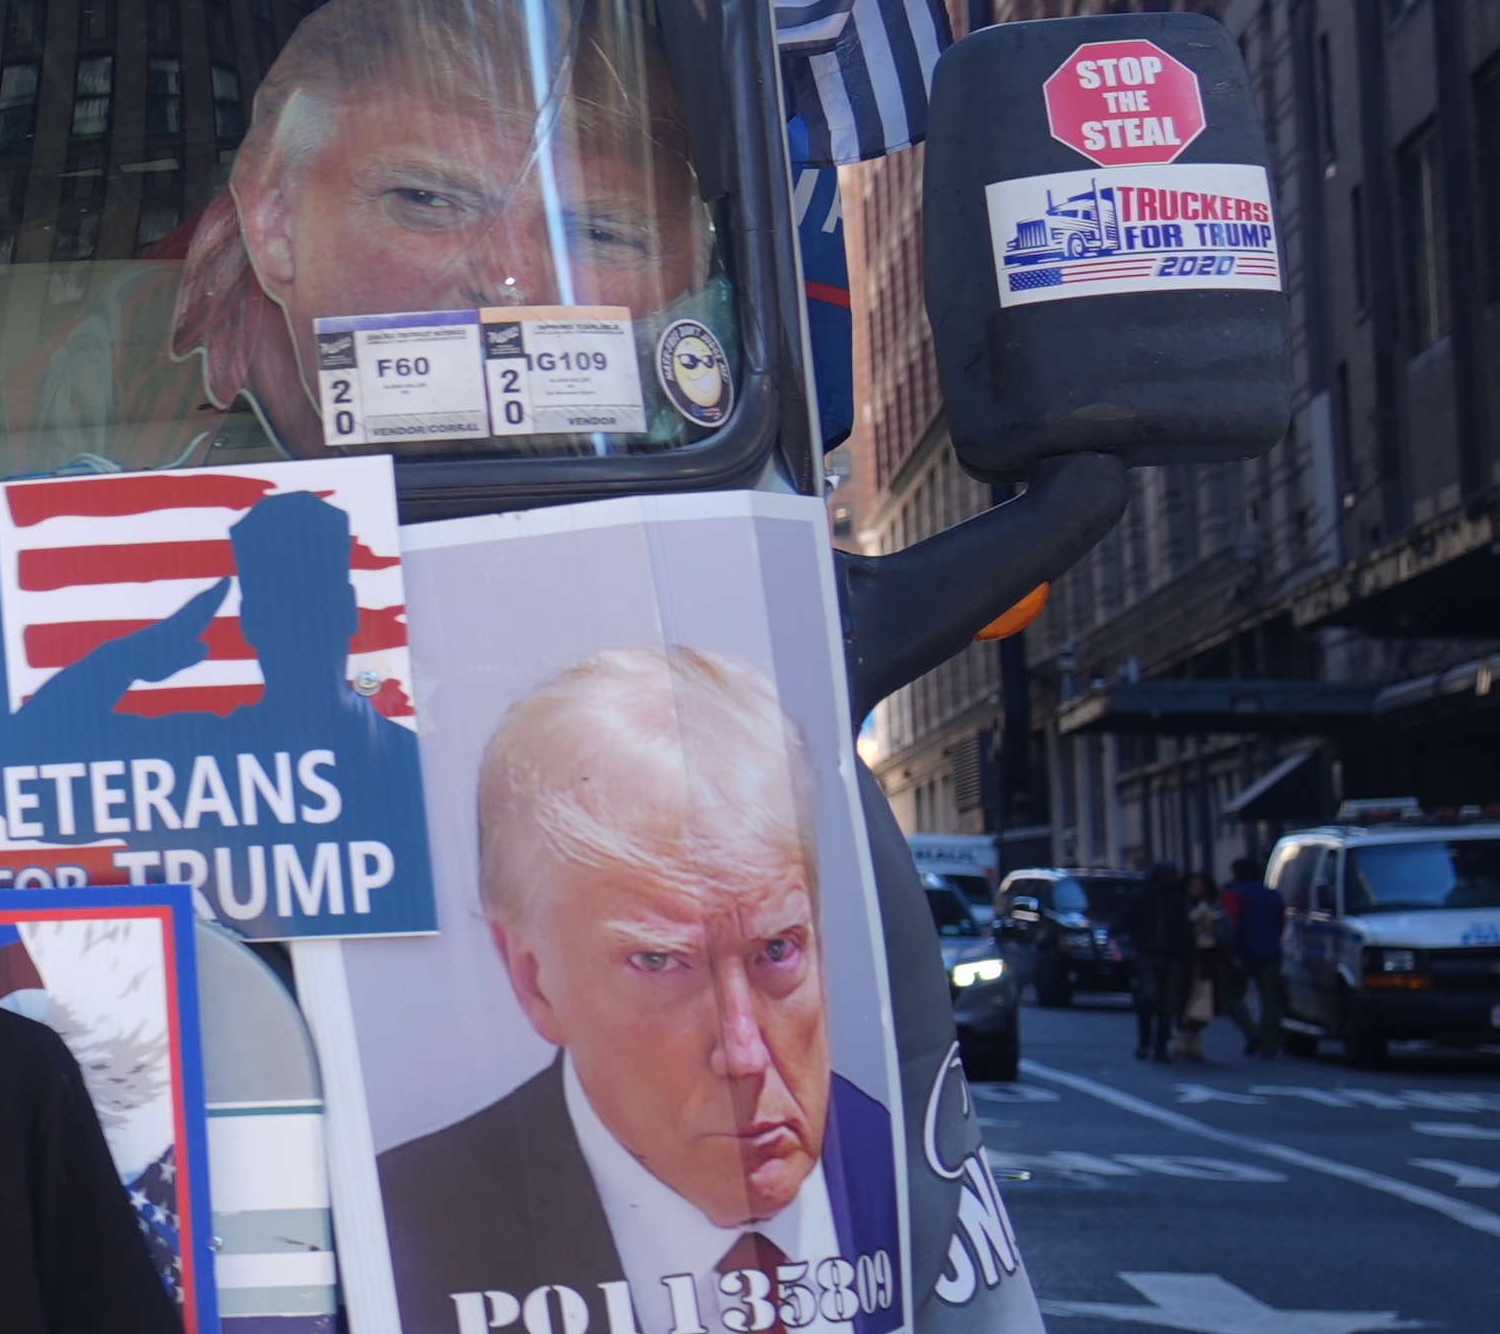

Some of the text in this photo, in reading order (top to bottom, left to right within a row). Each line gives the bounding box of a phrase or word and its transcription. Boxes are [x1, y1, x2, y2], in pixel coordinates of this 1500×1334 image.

[1075, 56, 1163, 90] STOP
[1102, 91, 1150, 113] THE
[1081, 116, 1181, 151] STEAL
[1117, 186, 1269, 223] TRUCKERS
[1123, 222, 1271, 250] FOR TRUMP
[1156, 256, 1236, 277] 2020
[377, 357, 430, 377] F60
[373, 423, 481, 436] VENDOR CORRAL
[567, 417, 617, 426] VENDOR
[114, 839, 395, 920] TRUMP
